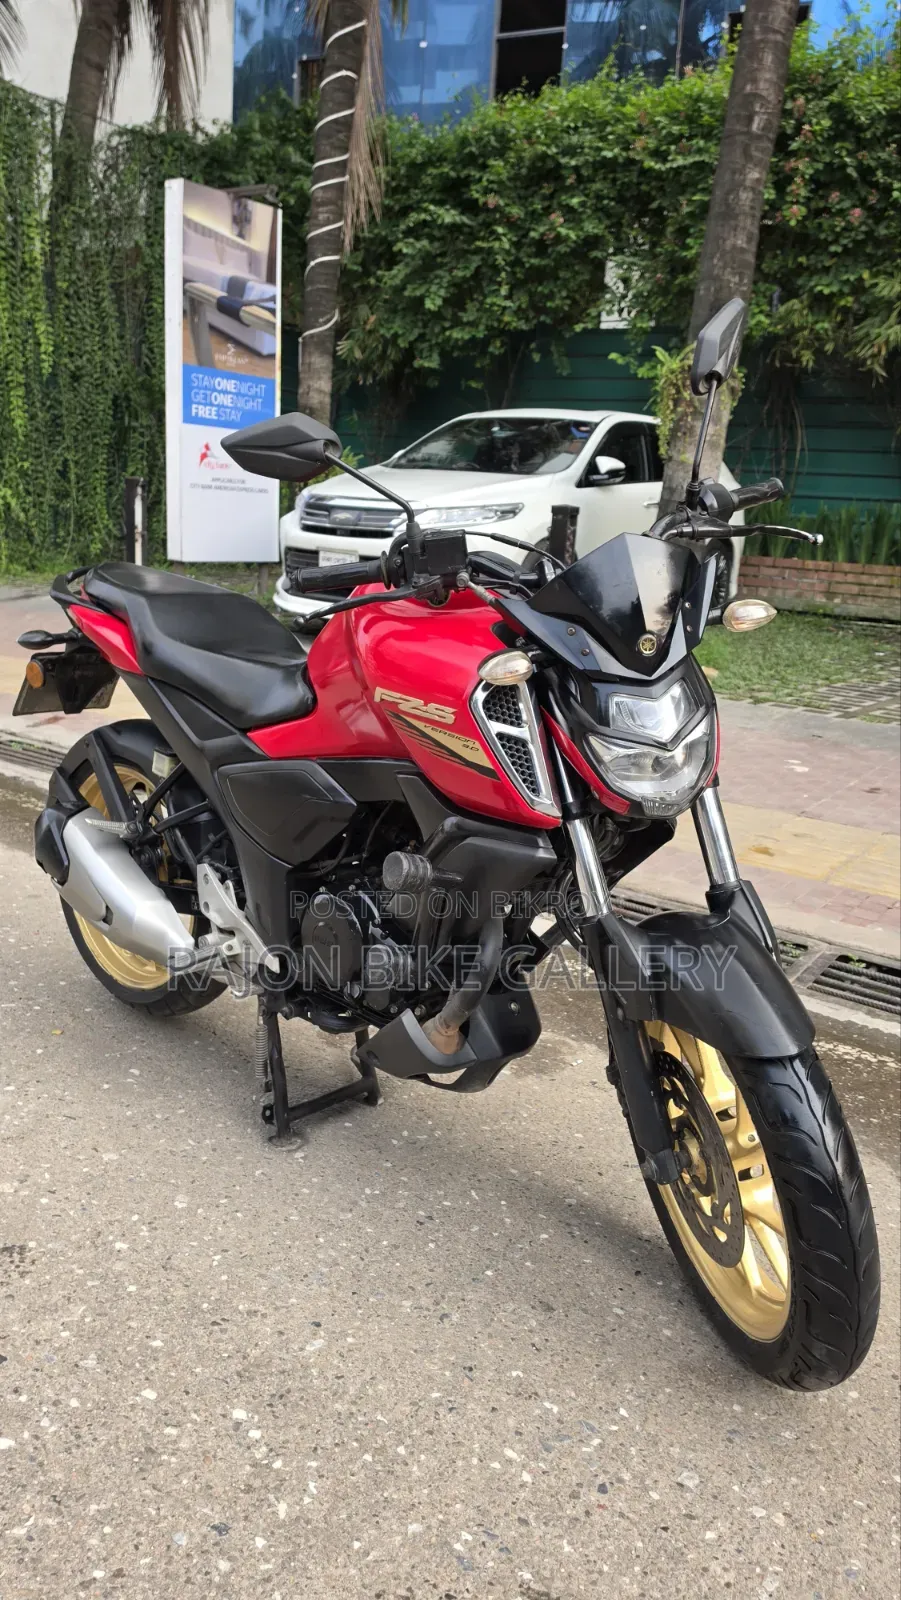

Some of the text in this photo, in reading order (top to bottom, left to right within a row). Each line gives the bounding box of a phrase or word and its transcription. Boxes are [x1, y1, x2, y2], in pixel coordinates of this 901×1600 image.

[191, 404, 242, 422] FREE STAY
[424, 724, 477, 746] VERSION
